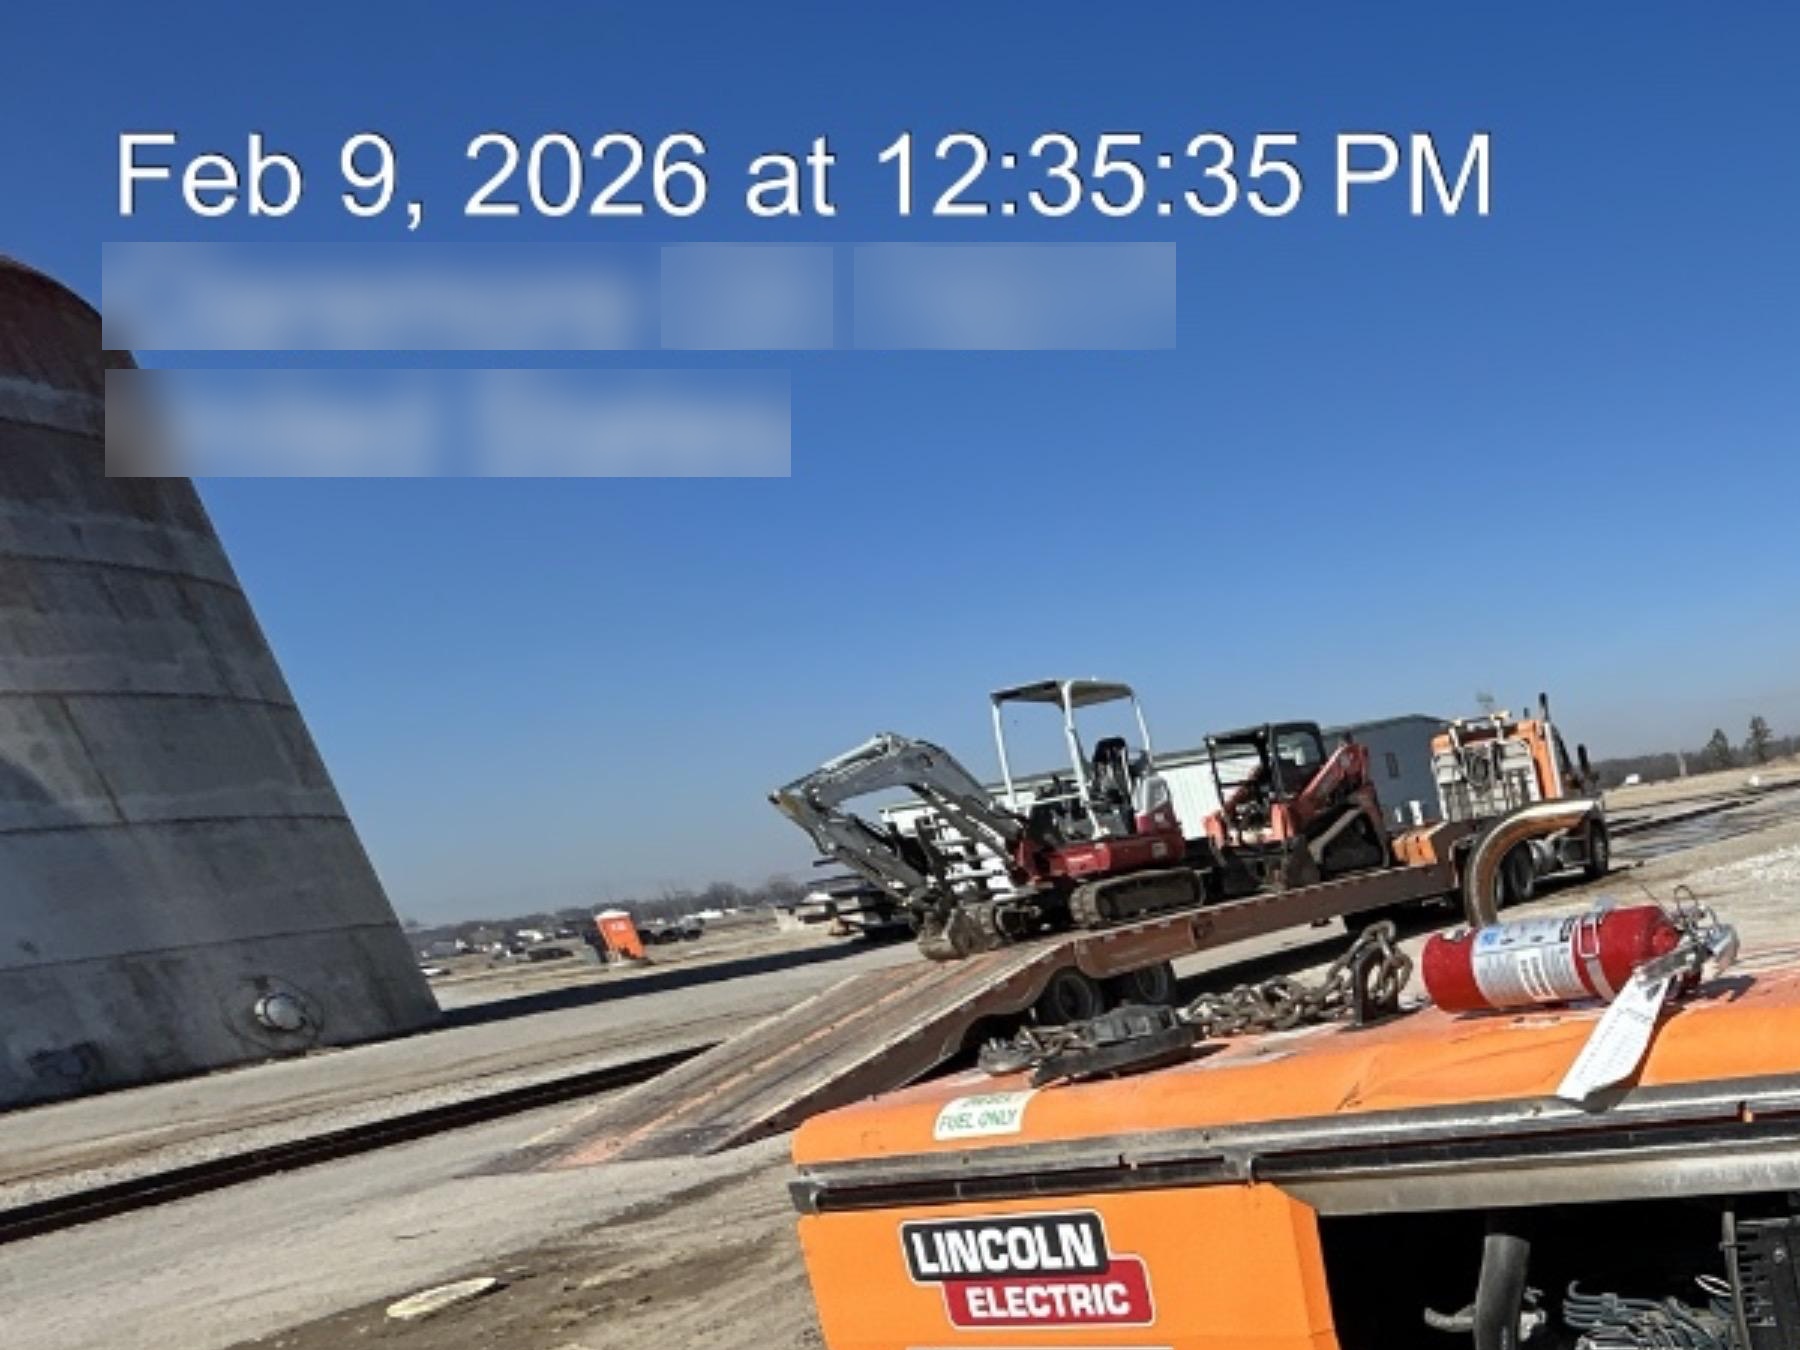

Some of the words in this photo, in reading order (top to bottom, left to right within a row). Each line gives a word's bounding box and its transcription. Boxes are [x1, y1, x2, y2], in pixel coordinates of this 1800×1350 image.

[938, 1112, 974, 1132] FUEL
[977, 1108, 1018, 1129] ONLY
[910, 1222, 1100, 1275] LINCOLN
[964, 1282, 1132, 1319] ELECTRIC
